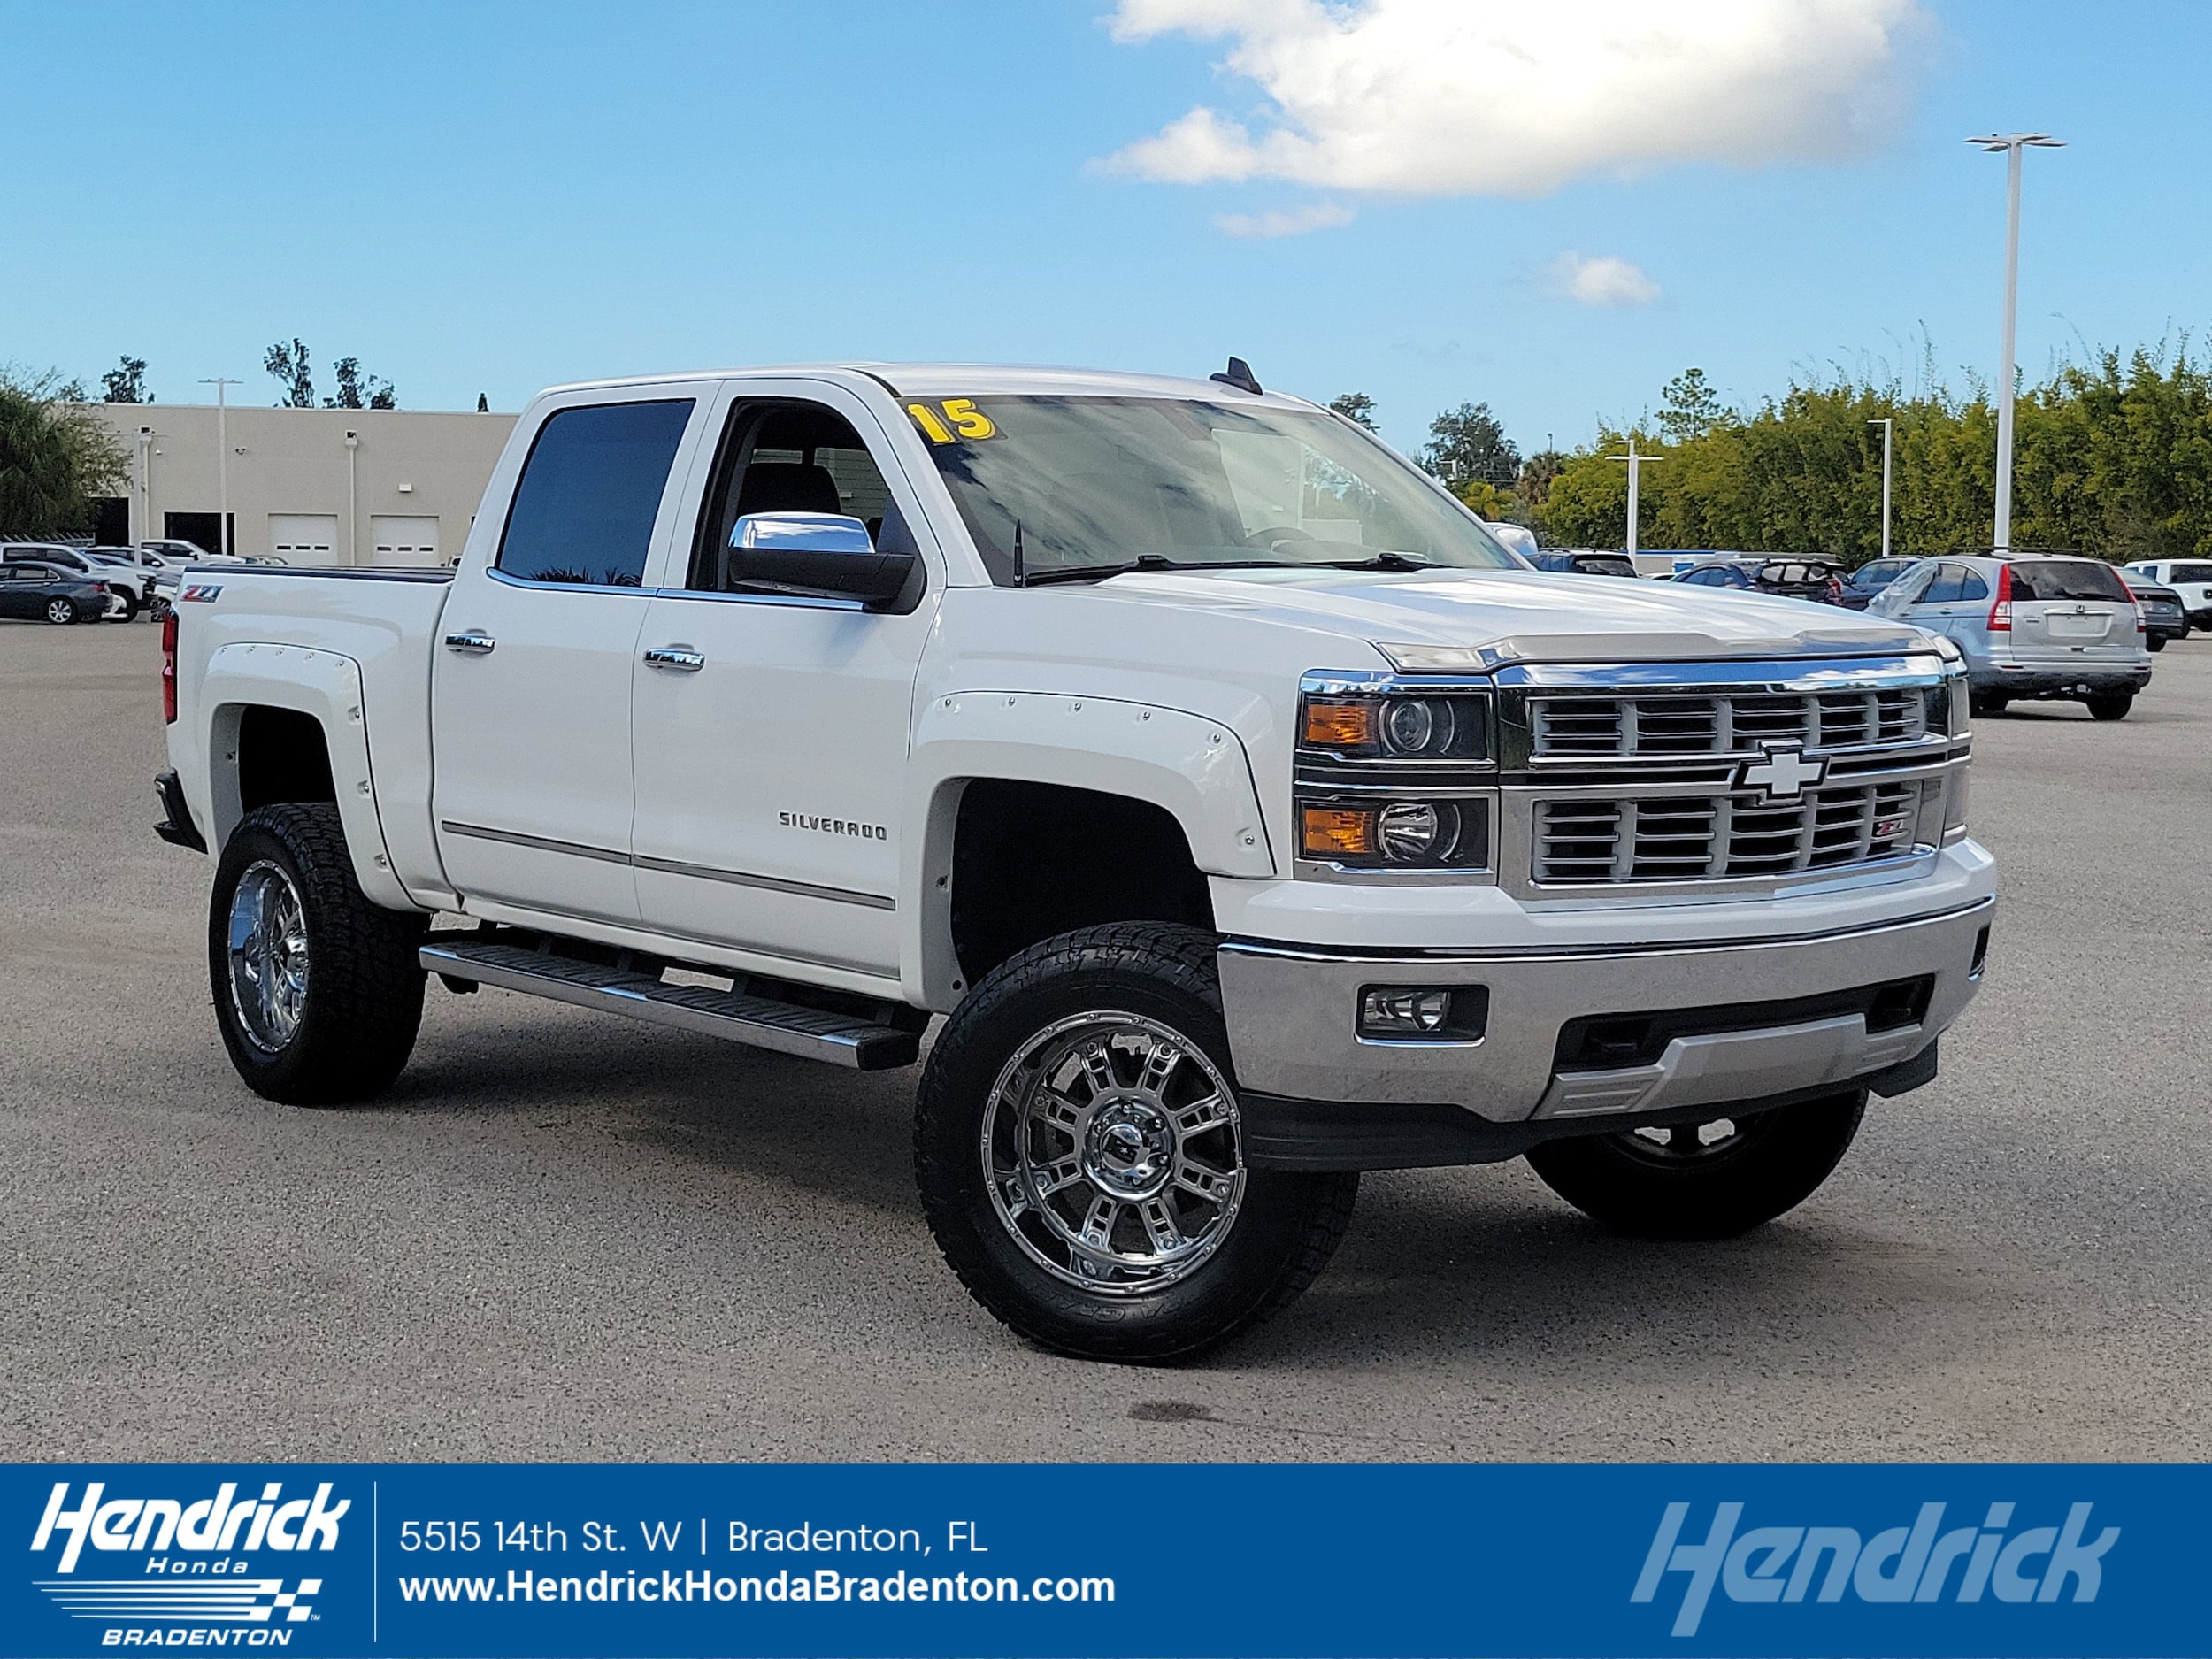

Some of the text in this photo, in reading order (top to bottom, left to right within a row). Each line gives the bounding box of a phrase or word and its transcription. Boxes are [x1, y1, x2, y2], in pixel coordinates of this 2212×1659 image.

[908, 399, 995, 443] 15
[180, 584, 224, 603] Z71
[779, 811, 887, 841] SILVERADO
